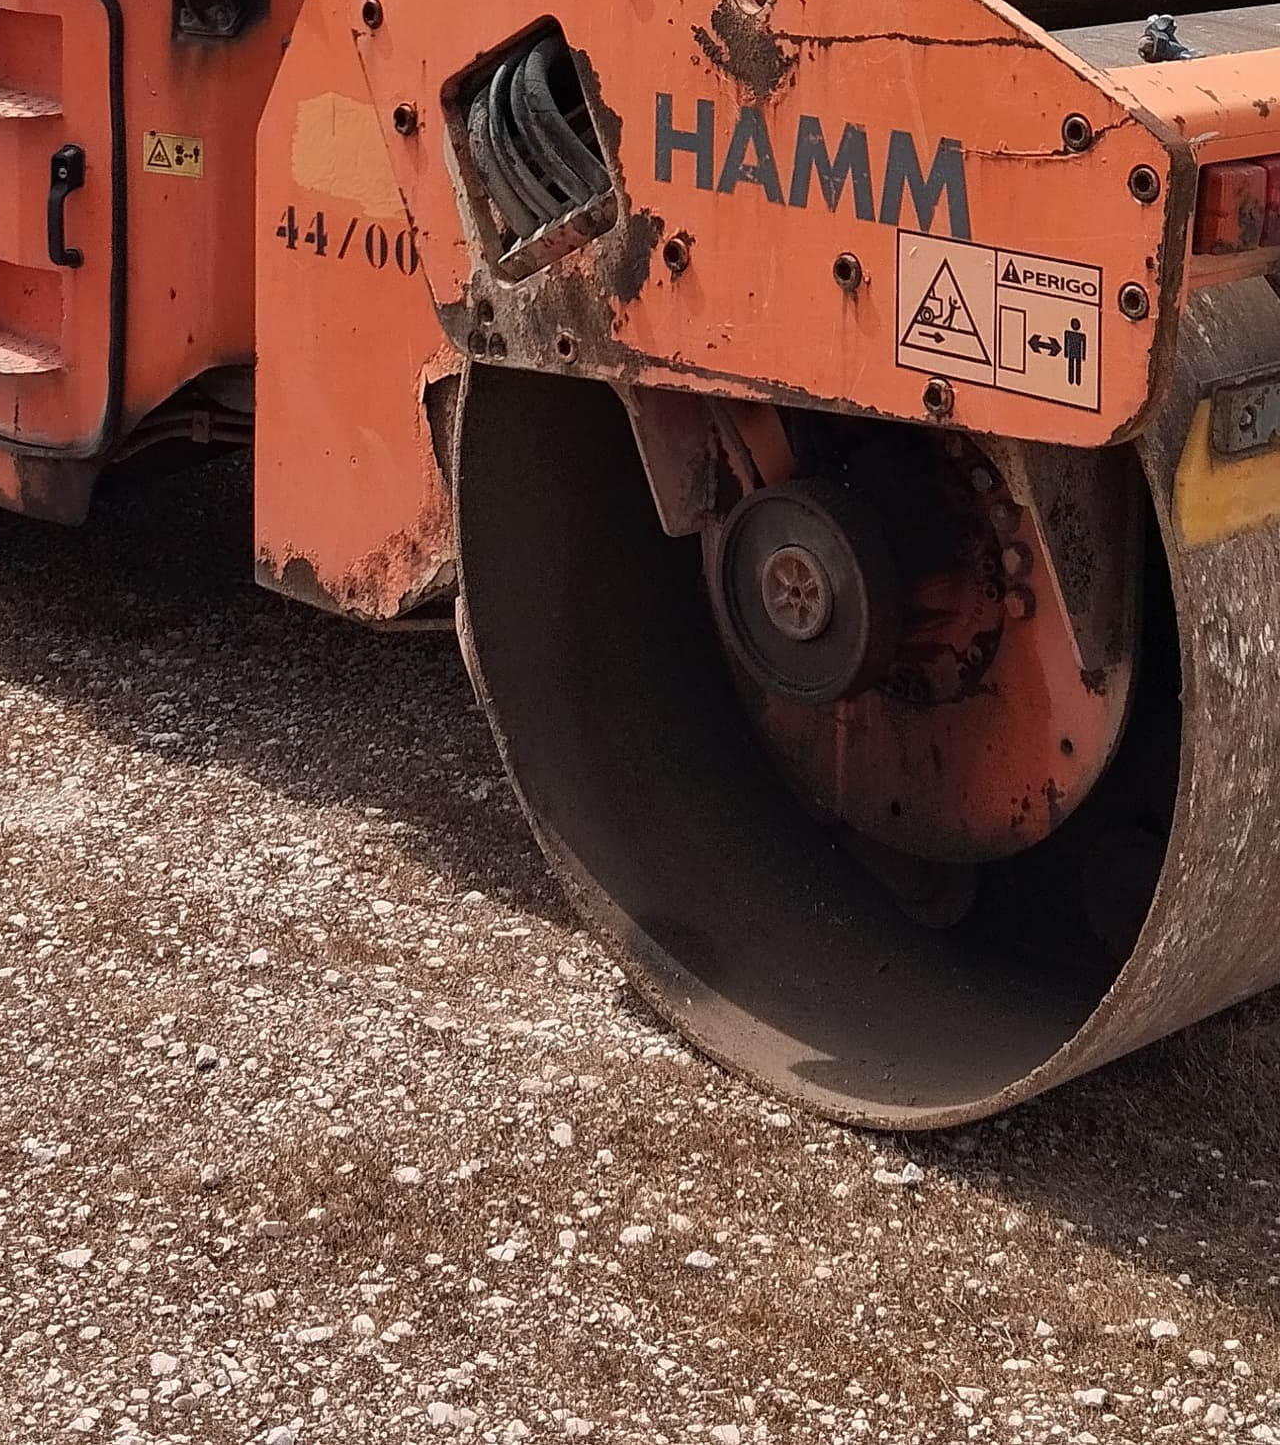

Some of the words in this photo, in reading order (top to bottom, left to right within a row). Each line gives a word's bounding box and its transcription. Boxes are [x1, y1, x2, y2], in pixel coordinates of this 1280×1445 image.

[655, 92, 971, 241] HAMM
[276, 205, 420, 276] 44/00
[1022, 269, 1097, 297] PERIGO
